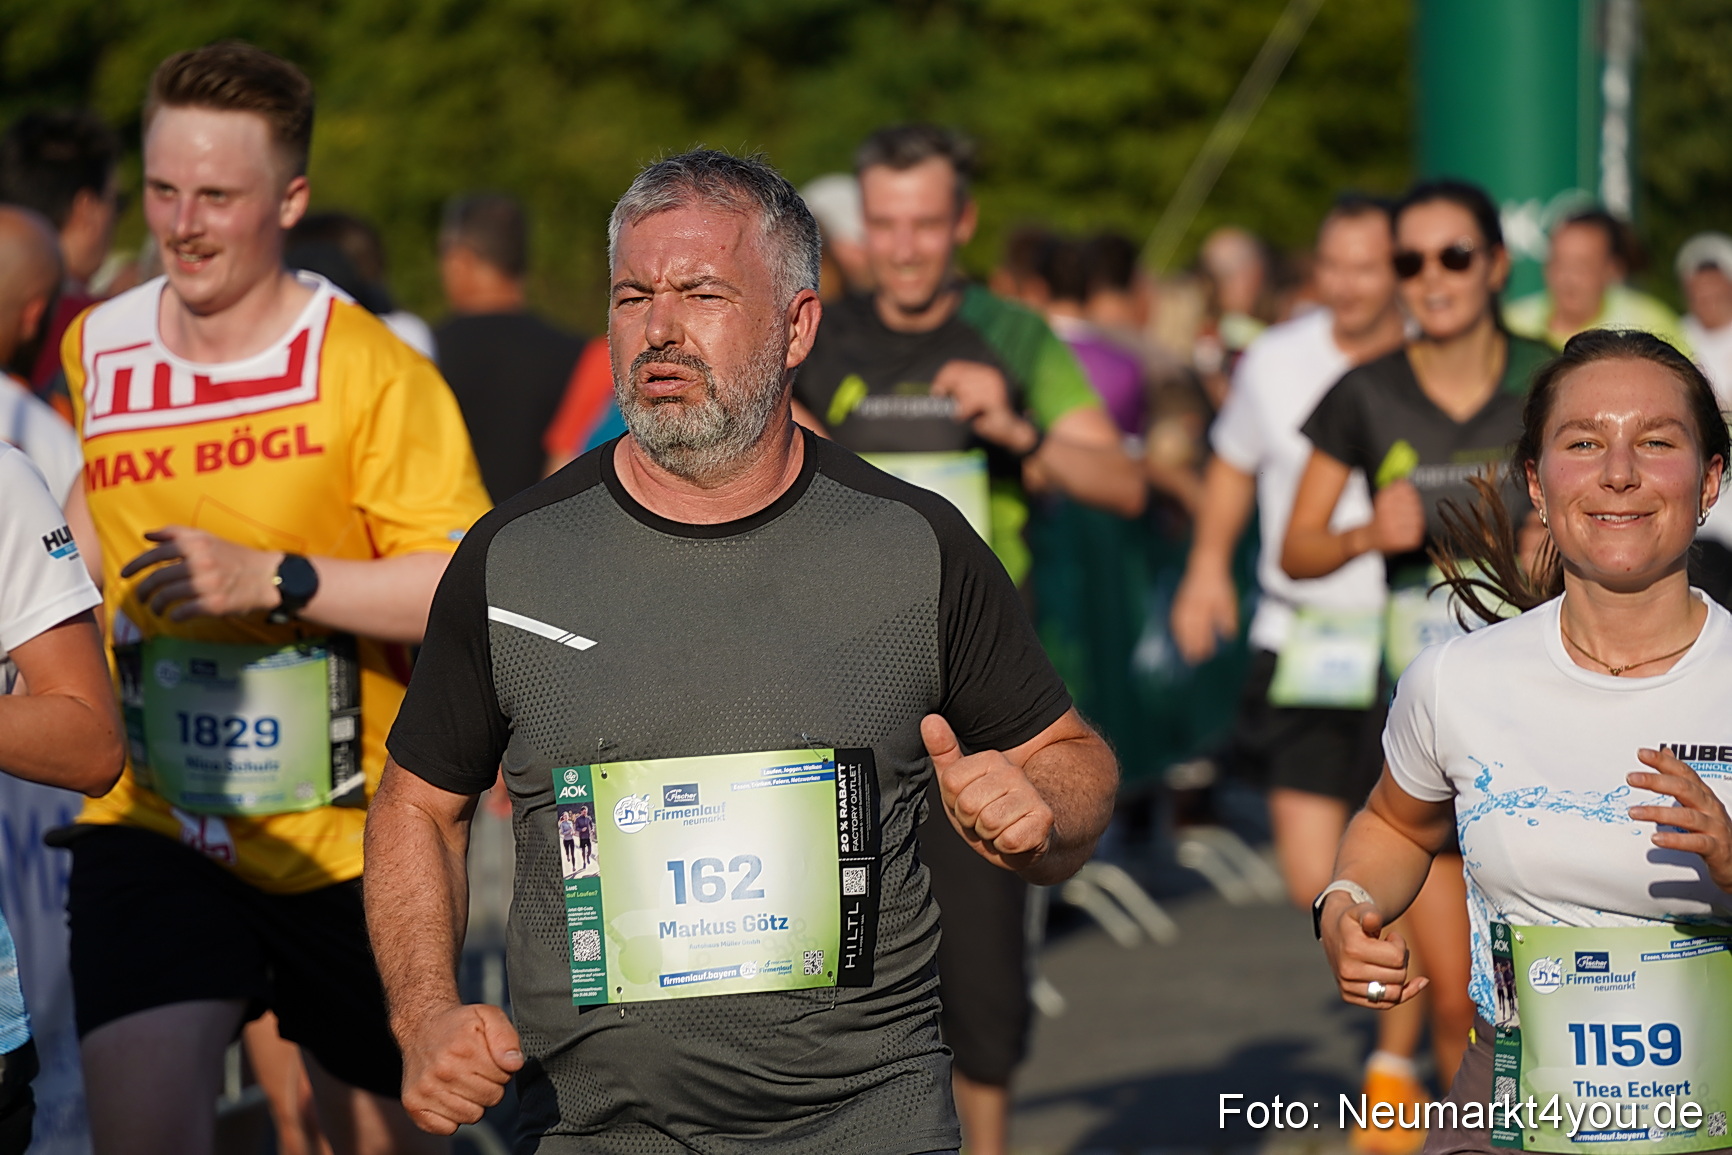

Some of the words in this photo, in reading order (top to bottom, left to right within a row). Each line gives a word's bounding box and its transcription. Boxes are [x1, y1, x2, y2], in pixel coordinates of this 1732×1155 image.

[85, 446, 175, 490] MAX
[195, 425, 324, 473] BÖGL
[176, 711, 280, 748] 1829
[1690, 763, 1732, 773] CHNOLO
[559, 784, 587, 798] AOK
[837, 763, 848, 819] RABATT
[849, 763, 858, 804] OUTLET
[667, 790, 697, 802] Fischer
[654, 801, 727, 821] Firmenlauf
[683, 814, 726, 827] neumarkt
[840, 820, 849, 832] %
[850, 805, 860, 852] FACTORY
[841, 832, 849, 853] 20
[667, 854, 765, 905] 162
[659, 919, 736, 939] Markus
[743, 913, 789, 932] Götz
[844, 901, 859, 968] HILTL
[689, 942, 720, 950] Autohaus
[720, 940, 741, 948] Müller
[1493, 939, 1509, 953] AOK
[1578, 956, 1607, 968] Fischer
[663, 969, 737, 985] firmenlauf.bayern
[1566, 971, 1637, 984] Firmenlauf
[1594, 982, 1636, 992] neumarkt
[1568, 1023, 1681, 1067] 1159
[1573, 1081, 1622, 1098] Thea
[1628, 1080, 1691, 1098] Eckert
